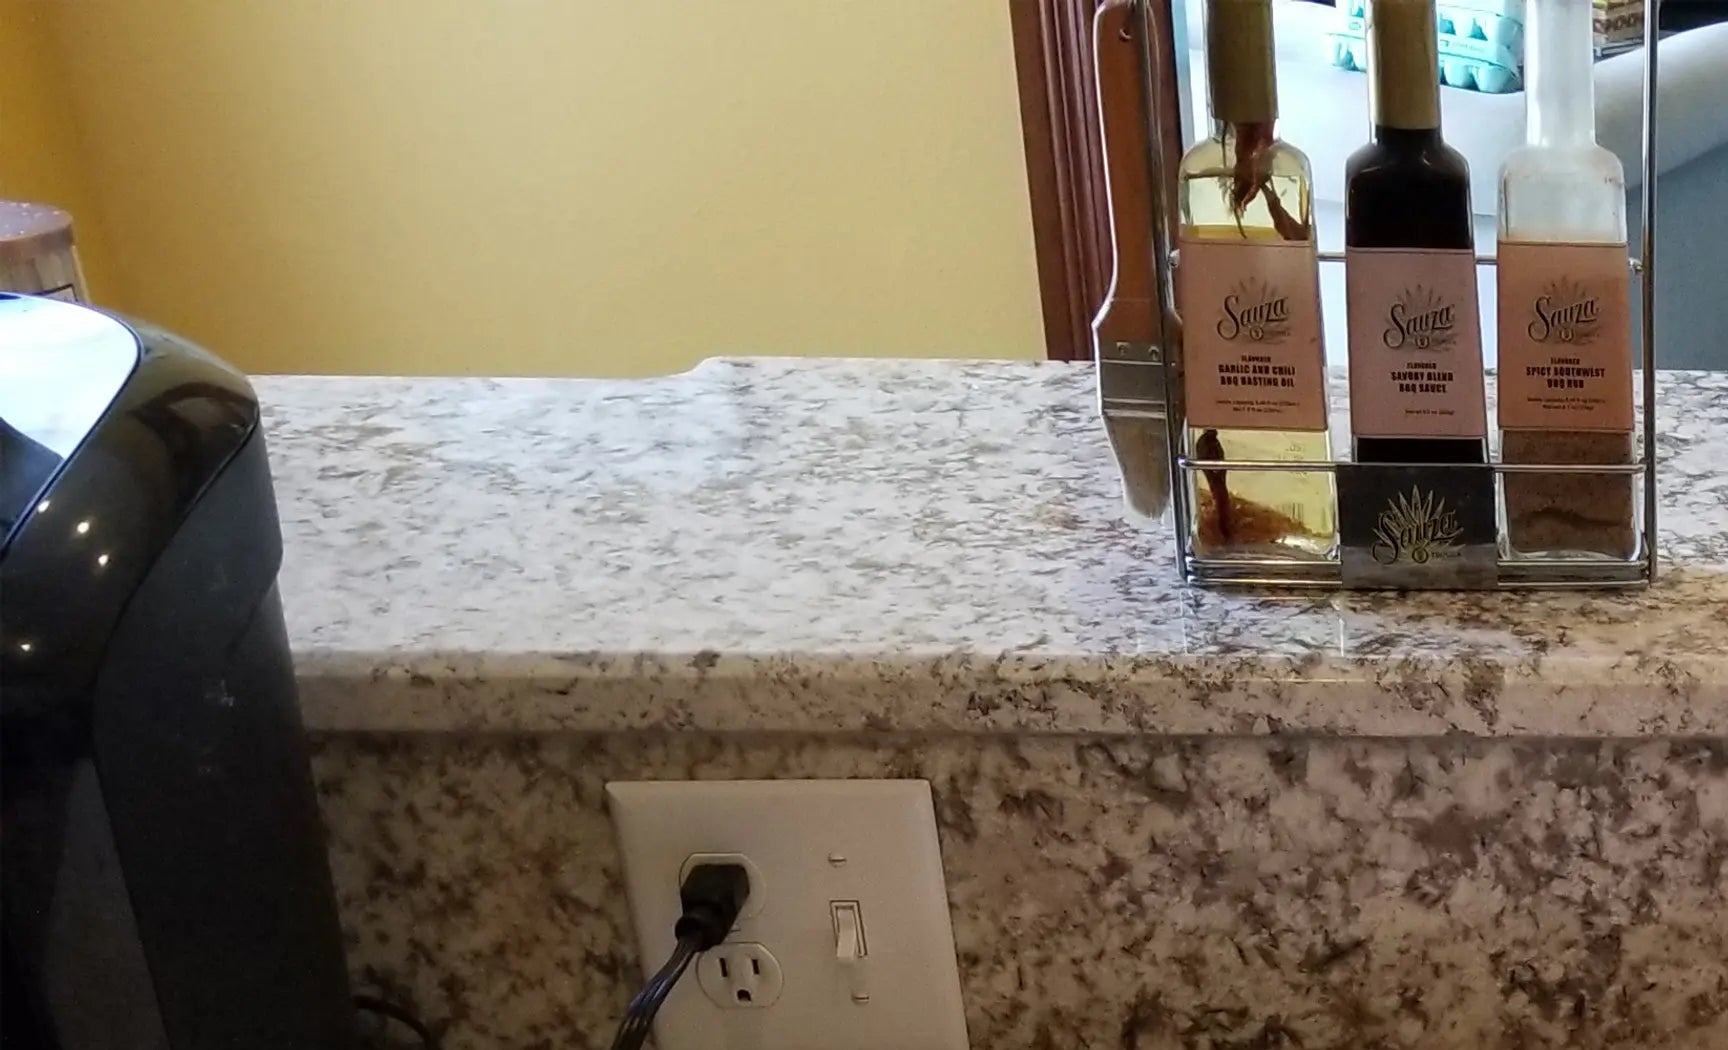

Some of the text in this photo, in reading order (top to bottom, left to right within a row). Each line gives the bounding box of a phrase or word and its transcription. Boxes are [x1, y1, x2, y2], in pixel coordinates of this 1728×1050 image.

[1217, 295, 1289, 340] Sauza
[1528, 296, 1600, 342] Sauza
[1383, 303, 1455, 348] Sauza
[1218, 364, 1250, 374] GARLIC
[1252, 365, 1270, 374] AND
[1526, 366, 1605, 378] SPICY SOUTHWEST
[1220, 376, 1295, 387] BBQ BASTING OIL
[1391, 371, 1425, 381] SAVORY
[1399, 383, 1446, 393] BBQ SAUCE
[1372, 510, 1464, 564] Sauza
